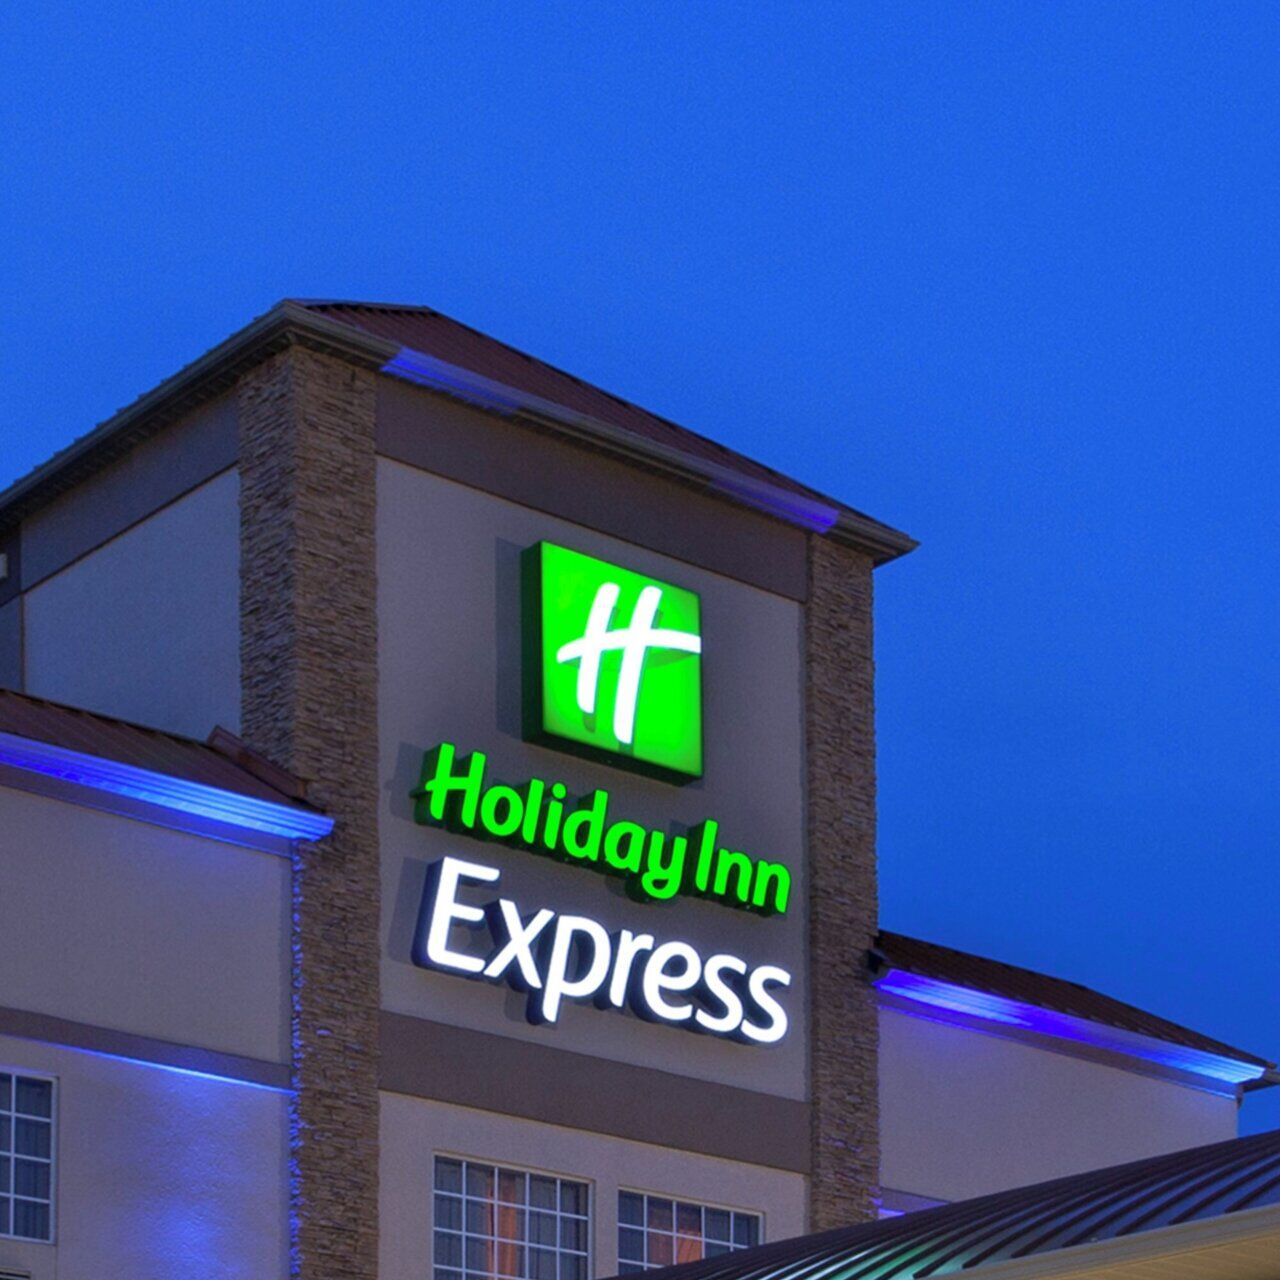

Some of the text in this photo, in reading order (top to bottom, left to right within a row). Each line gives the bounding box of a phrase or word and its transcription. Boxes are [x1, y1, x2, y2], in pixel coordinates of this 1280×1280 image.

[425, 742, 791, 913] Holiday Inn
[426, 856, 791, 1043] Express
